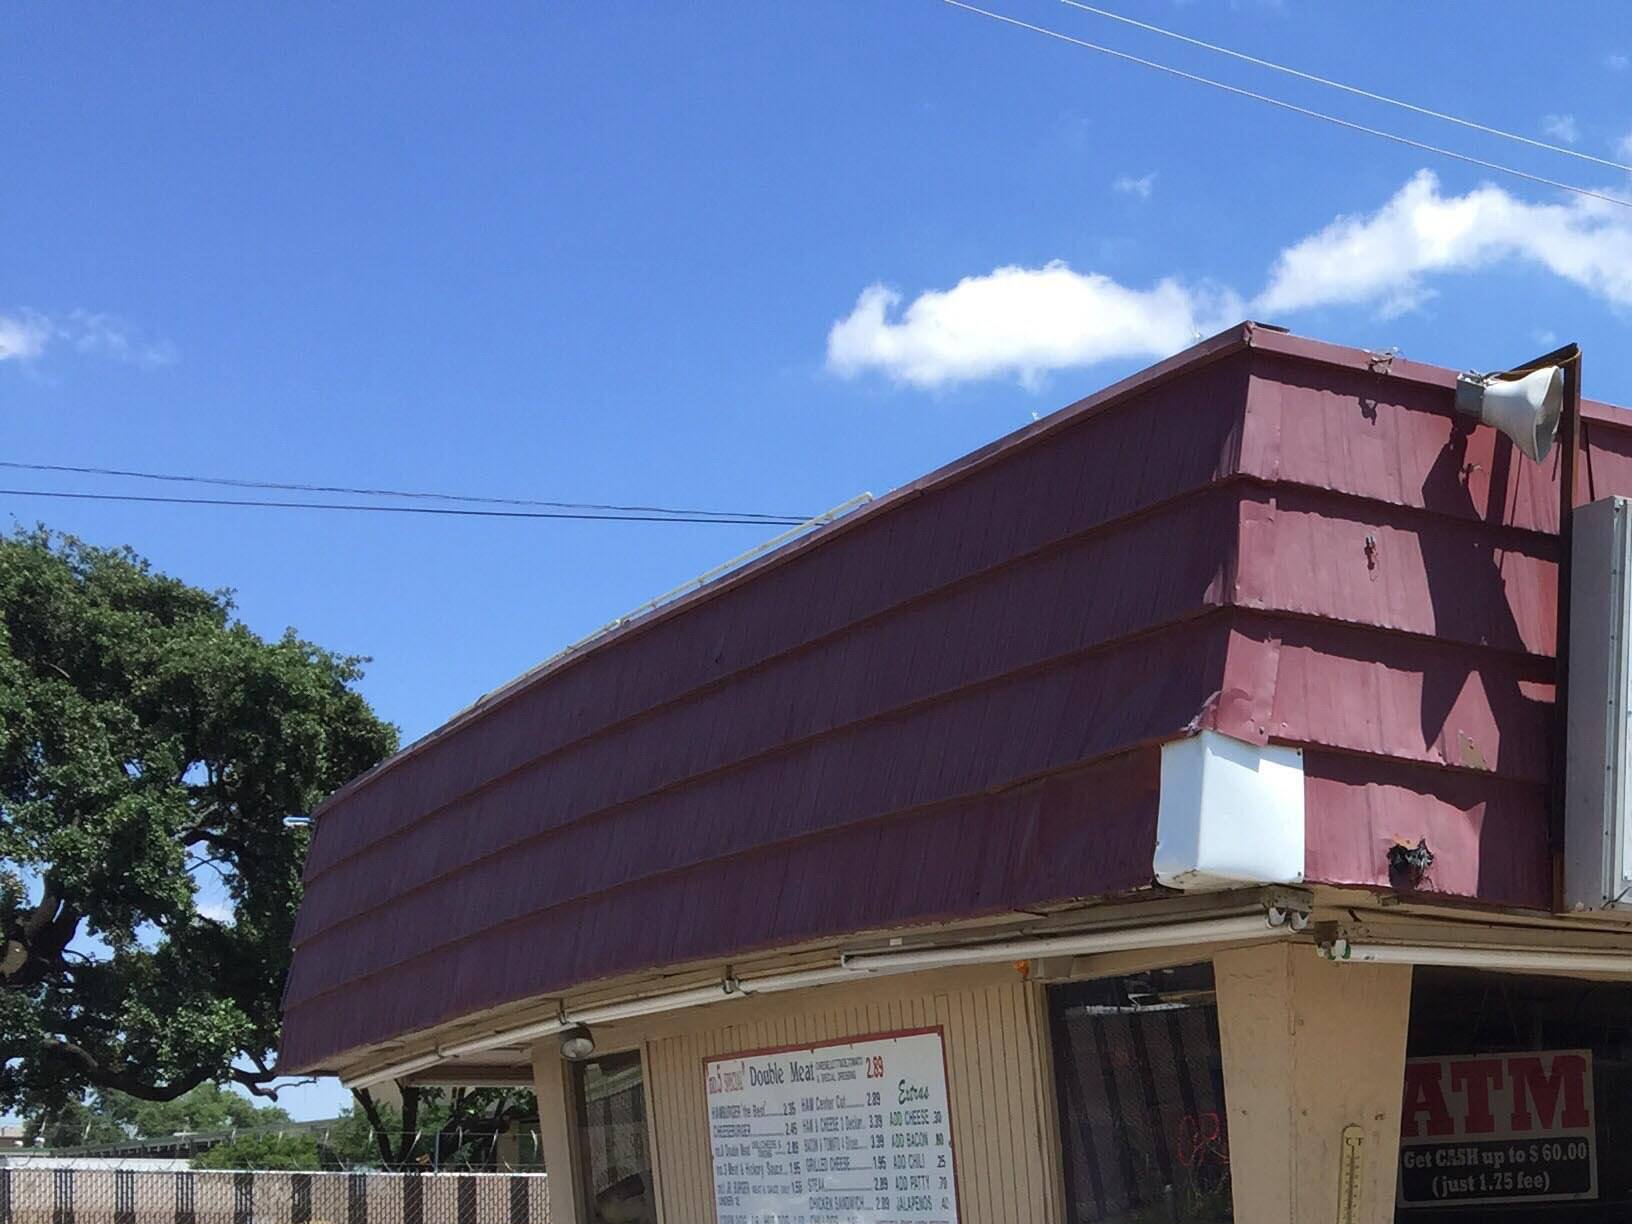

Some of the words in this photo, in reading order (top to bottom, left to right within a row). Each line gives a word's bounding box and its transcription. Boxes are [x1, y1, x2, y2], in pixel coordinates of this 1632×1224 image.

[749, 1061, 784, 1087] Double
[790, 1061, 815, 1083] Meat
[865, 1055, 884, 1079] 2.89
[898, 1079, 930, 1105] Extras
[1400, 1054, 1590, 1138] ATM
[890, 1111, 902, 1127] ADD
[905, 1109, 929, 1125] CHEESE
[891, 1133, 905, 1149] ADD
[907, 1132, 929, 1148] BACON
[805, 1157, 828, 1172] GRILLED
[829, 1156, 850, 1171] CHEESE
[872, 1155, 887, 1170] 1.95
[893, 1154, 906, 1170] ADD
[908, 1153, 925, 1169] CHILI
[1403, 1150, 1433, 1169] Get
[1435, 1147, 1479, 1169] CASH
[1481, 1150, 1505, 1170] up
[1508, 1147, 1527, 1164] to
[895, 1176, 908, 1191] ADD
[910, 1174, 930, 1190] PATTY
[1516, 1170, 1551, 1192] fee)
[808, 1195, 834, 1212] CHICKEN
[834, 1195, 865, 1212] SANDWICH
